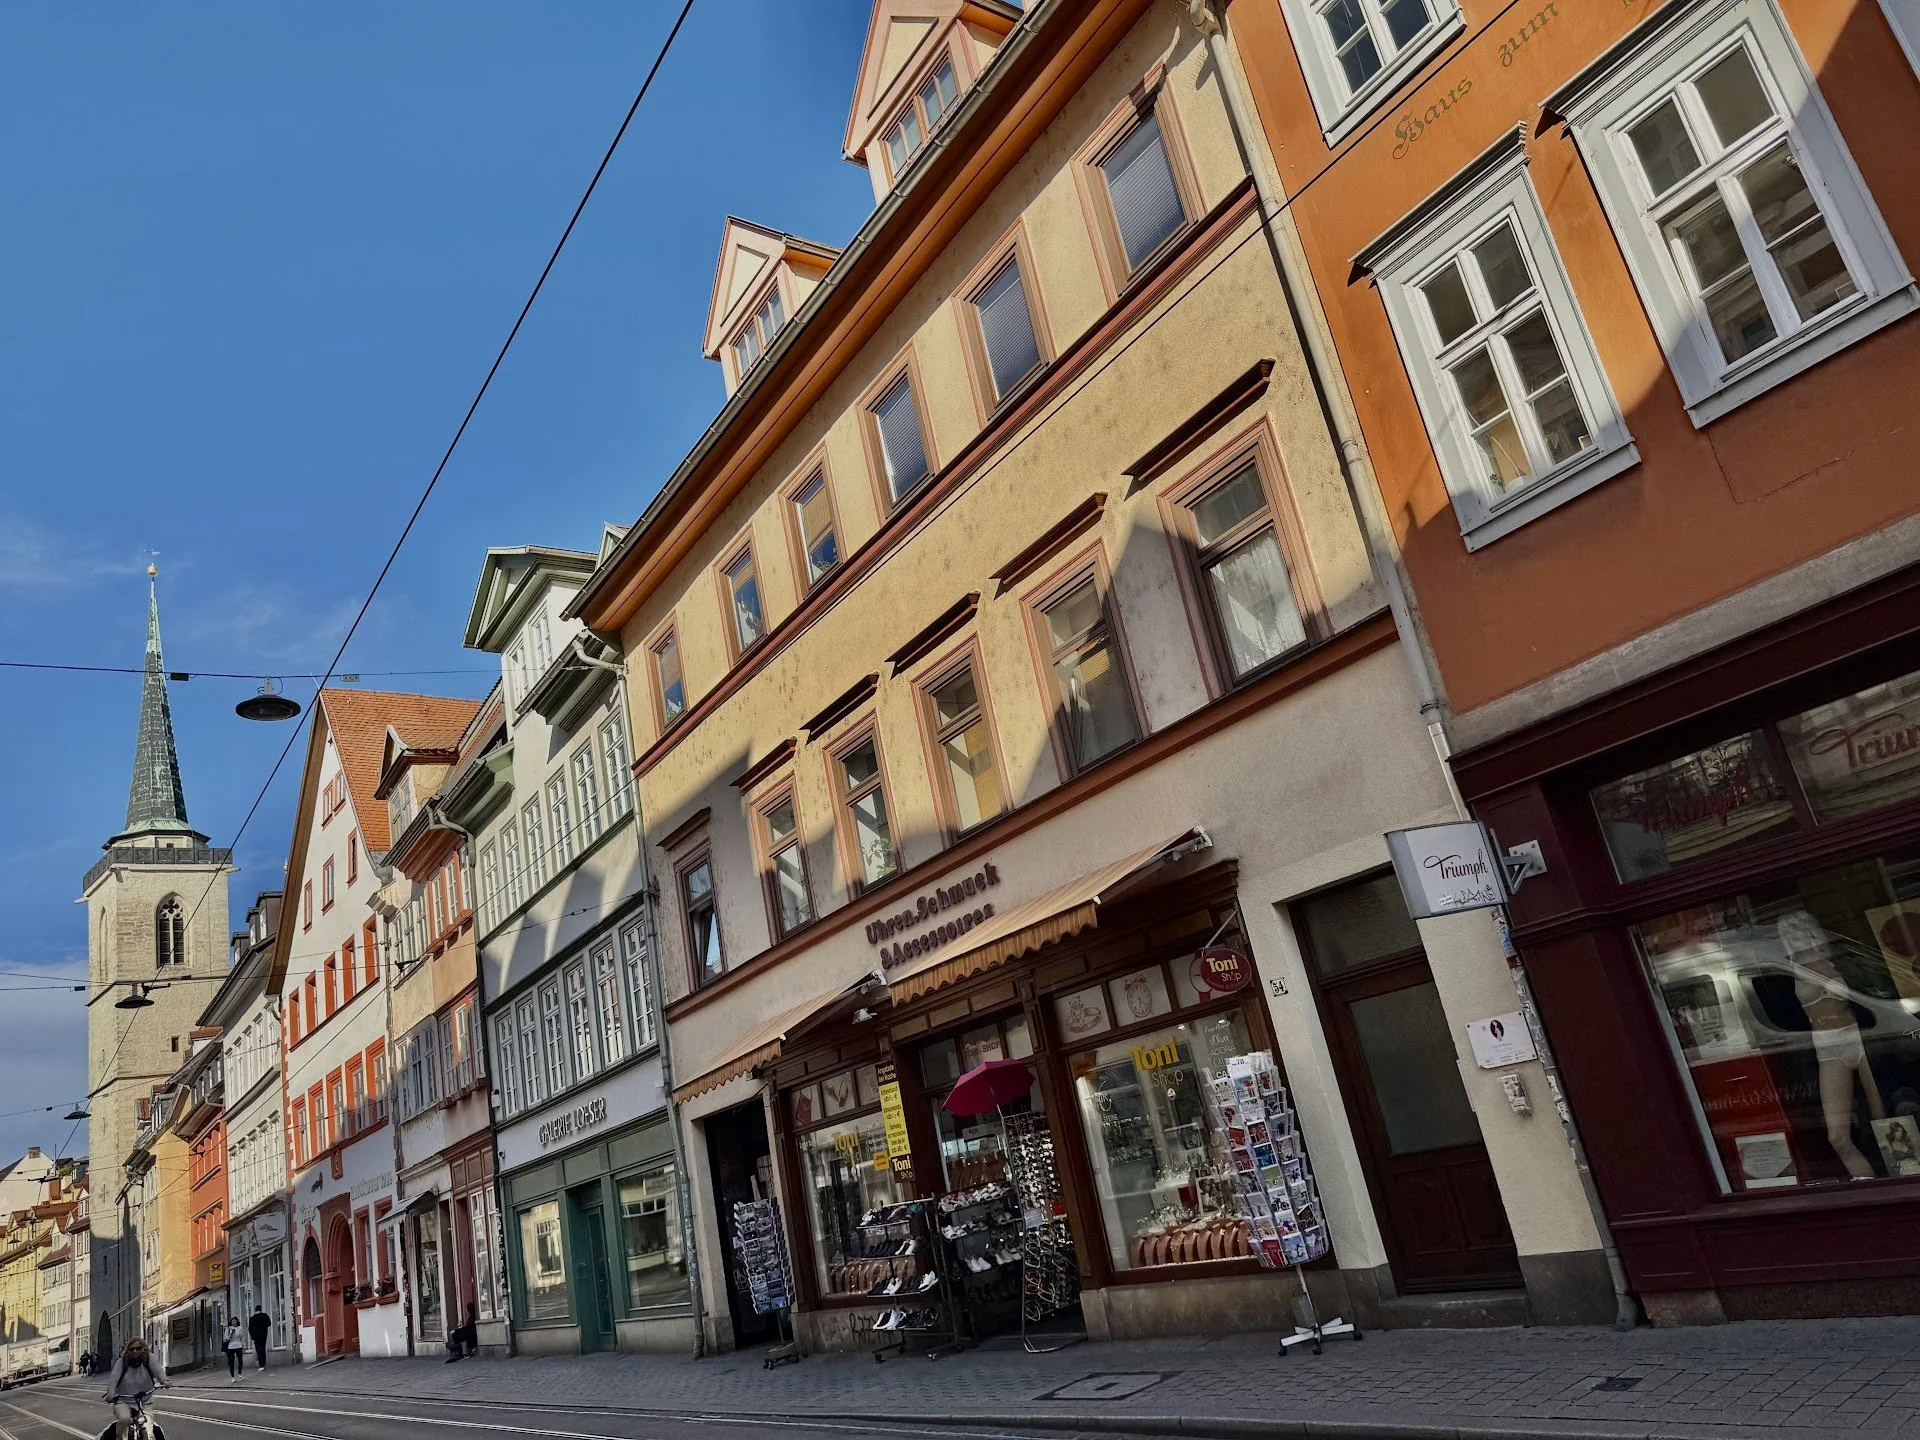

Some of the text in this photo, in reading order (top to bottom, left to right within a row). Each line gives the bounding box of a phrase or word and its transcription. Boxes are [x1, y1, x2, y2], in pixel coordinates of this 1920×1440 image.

[1392, 2, 1559, 160] Haus zum
[1423, 848, 1489, 884] Triumph
[1206, 954, 1239, 973] Toni
[1221, 971, 1242, 982] Shop
[1130, 1035, 1181, 1073] Toni
[1151, 1069, 1184, 1088] Shop
[538, 1113, 572, 1145] GALERIE
[891, 1155, 912, 1172] Toni
